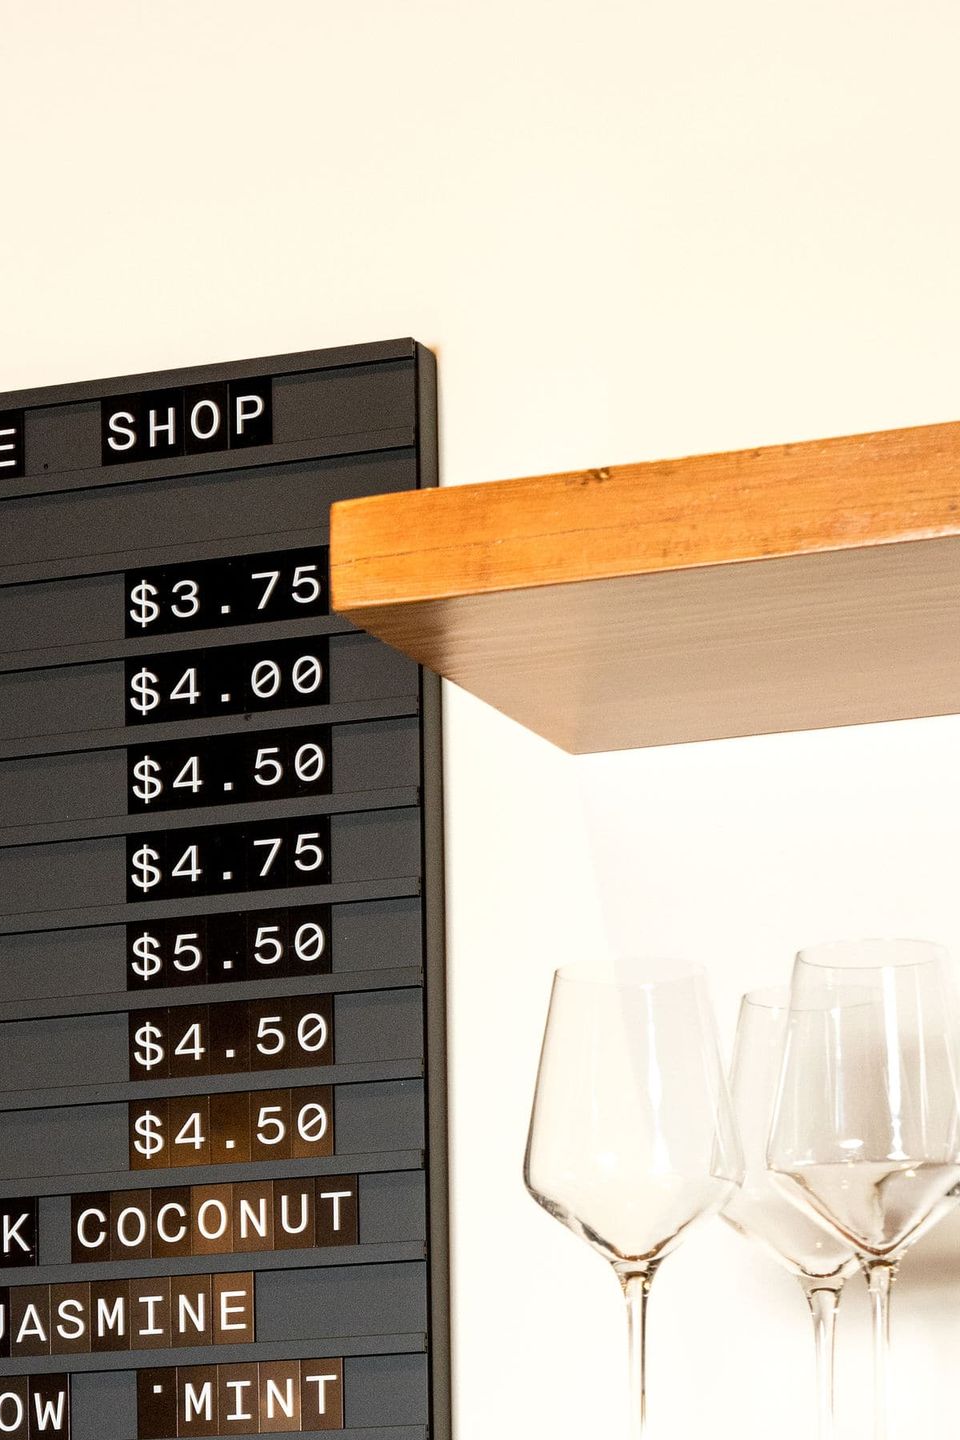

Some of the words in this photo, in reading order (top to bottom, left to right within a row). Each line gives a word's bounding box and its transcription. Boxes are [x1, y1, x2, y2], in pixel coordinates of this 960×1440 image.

[107, 395, 263, 451] SHOP
[129, 565, 320, 628] $3.75
[130, 655, 321, 716] $4.00
[132, 743, 324, 804] $4.50
[131, 832, 323, 893] $4.75
[131, 922, 324, 981] $5.50
[133, 1012, 327, 1071] $4.50
[133, 1103, 328, 1160] $4.50
[77, 1190, 352, 1248] COCONUT
